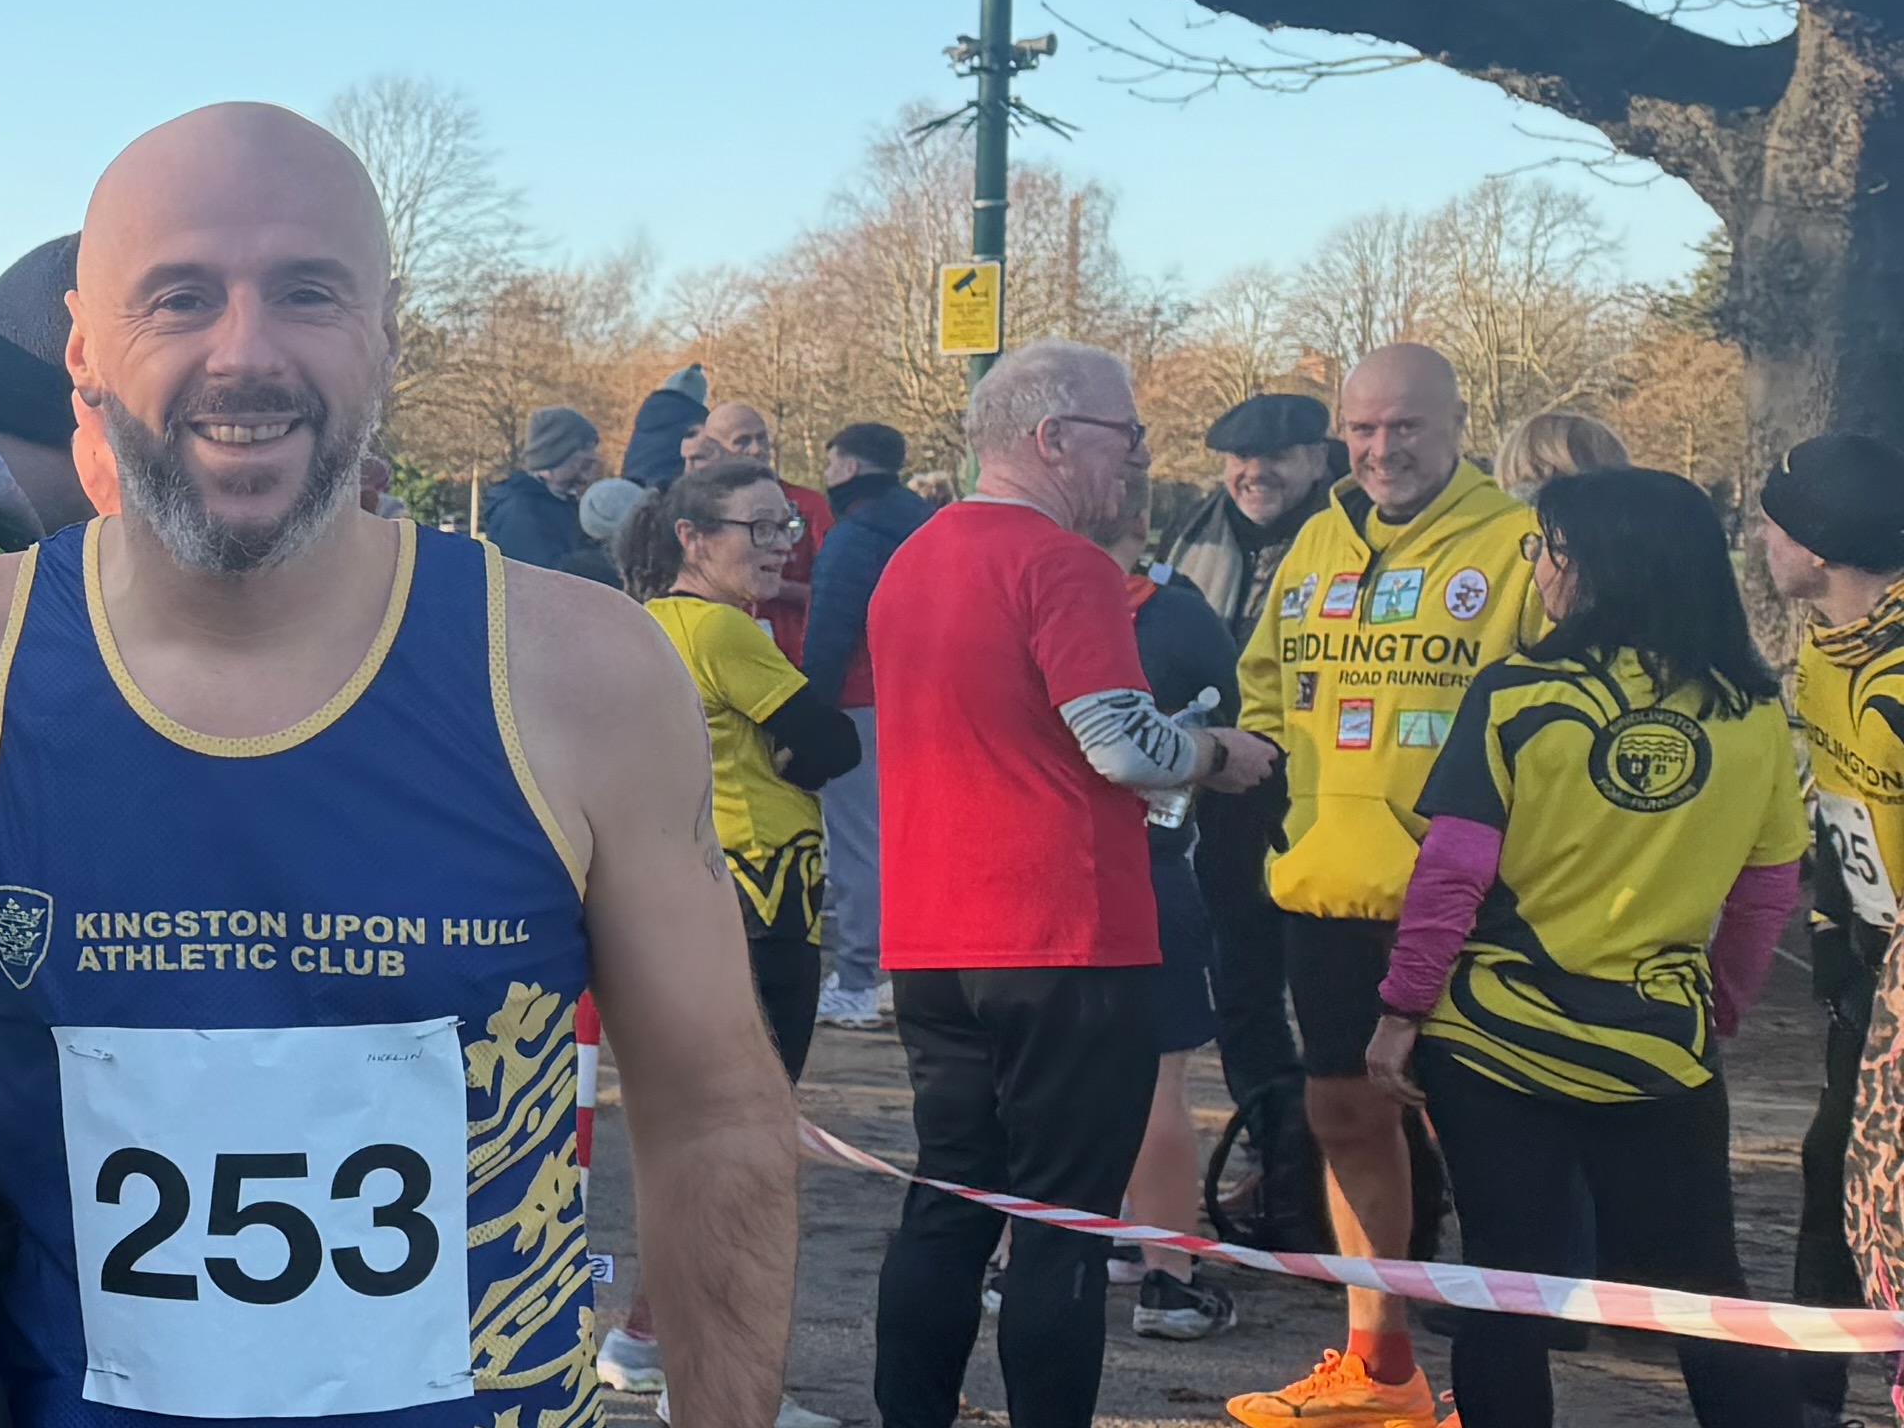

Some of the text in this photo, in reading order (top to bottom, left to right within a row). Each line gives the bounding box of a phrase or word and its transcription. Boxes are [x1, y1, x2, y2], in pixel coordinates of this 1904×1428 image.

[1339, 670, 1382, 686] ROAD
[75, 910, 530, 946] KINGSTON UPON HULL
[77, 943, 406, 977] ATHLETIC CLUB
[95, 1143, 440, 1306] 253
